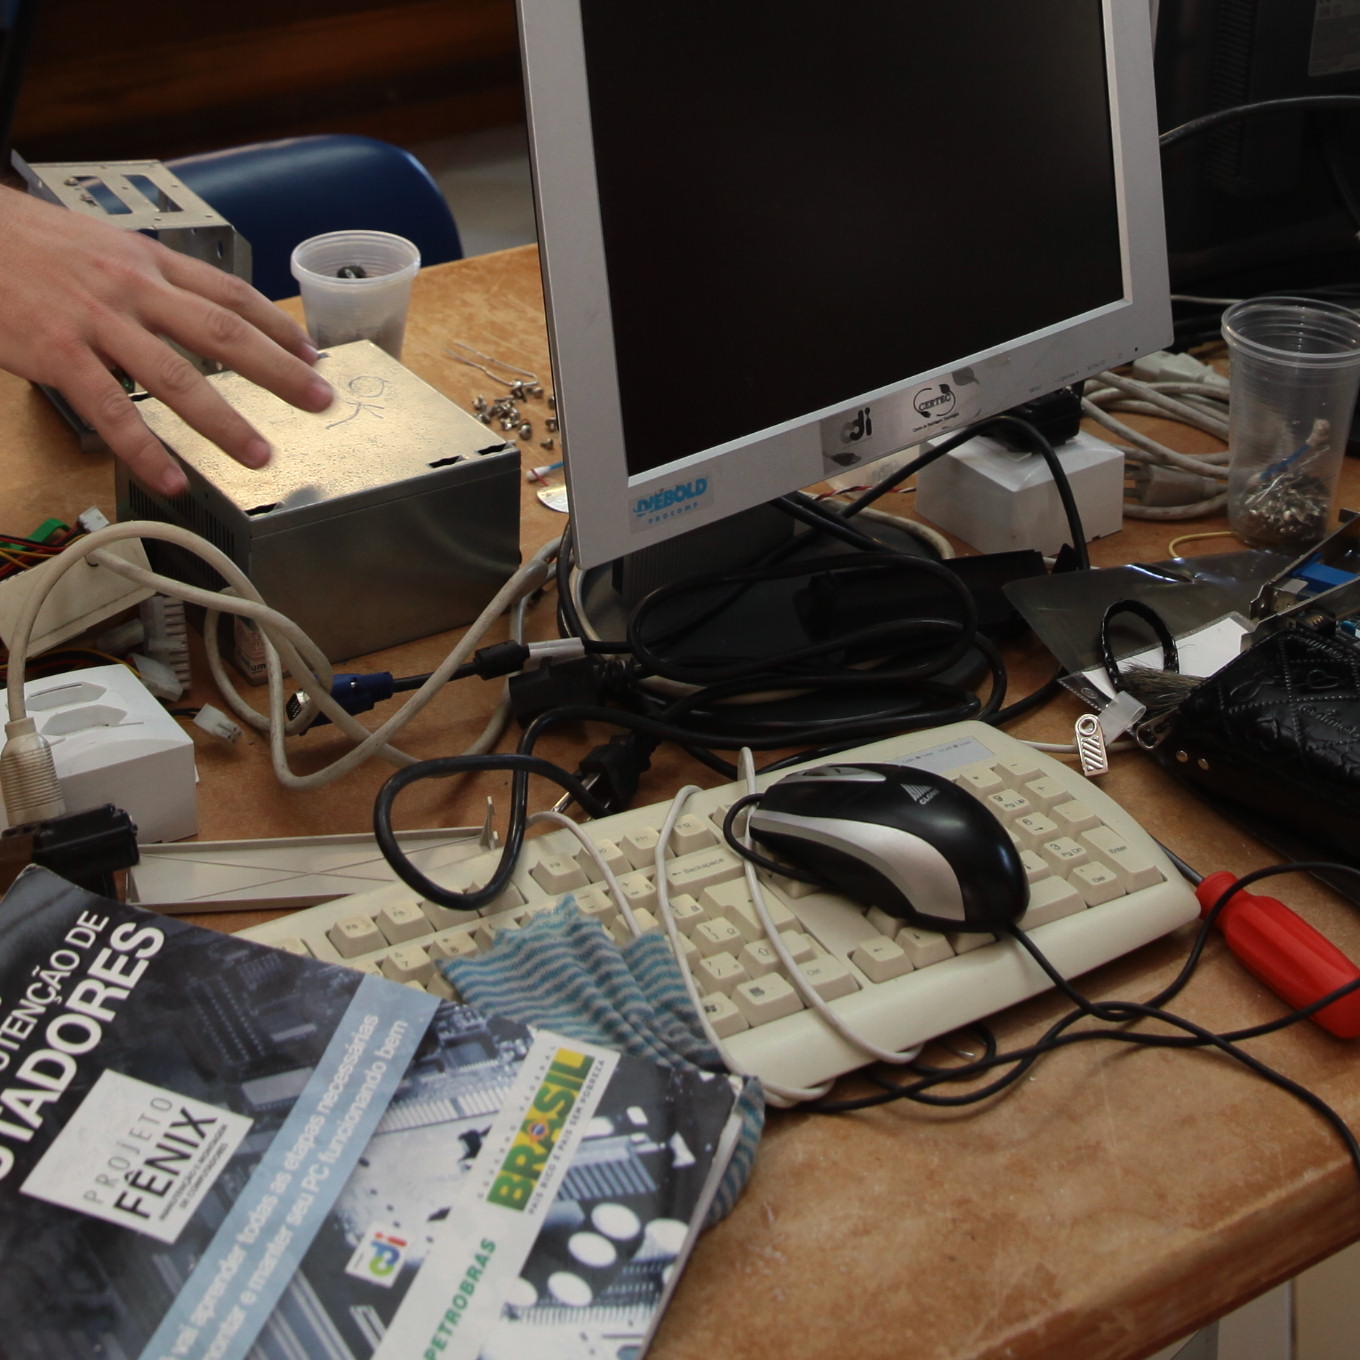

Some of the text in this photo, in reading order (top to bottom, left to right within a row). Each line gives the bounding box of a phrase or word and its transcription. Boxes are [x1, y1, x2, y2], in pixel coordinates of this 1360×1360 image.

[918, 392, 953, 412] CERTEC
[647, 502, 700, 525] PROCOMP
[64, 910, 110, 959] DE
[374, 1019, 409, 1060] bem
[318, 1060, 387, 1164] funcionando
[486, 1048, 596, 1212] BRASIL
[528, 1190, 544, 1215] PAÍS
[541, 1163, 557, 1189] RICO
[558, 1128, 573, 1152] PAÍS
[569, 1106, 583, 1126] SEM
[580, 1060, 606, 1105] POBREZA
[83, 1097, 173, 1205] PROJETO
[113, 1106, 218, 1220] FÊNIX
[191, 1244, 248, 1327] aprender
[236, 1194, 279, 1245] todas
[269, 1171, 292, 1195] as
[283, 1113, 326, 1172] etapas
[316, 1014, 379, 1115] necessárias
[301, 1163, 331, 1193] PC
[286, 1191, 316, 1227] seu
[246, 1224, 293, 1293] manter
[240, 1290, 258, 1306] e
[423, 1237, 497, 1360] PETROBRAS
